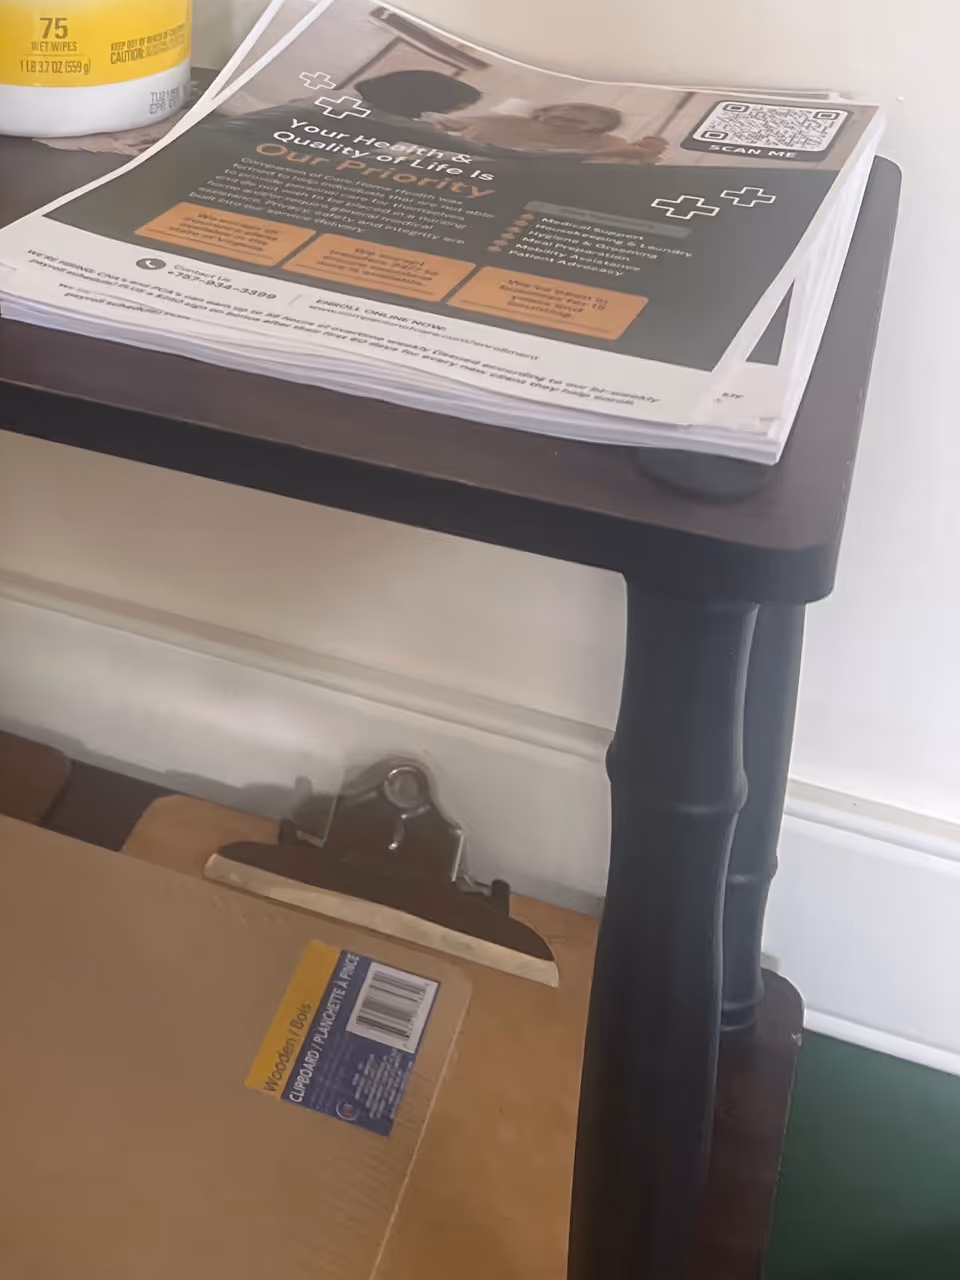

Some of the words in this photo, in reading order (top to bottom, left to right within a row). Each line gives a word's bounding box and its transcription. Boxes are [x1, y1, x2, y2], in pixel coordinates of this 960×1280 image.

[39, 17, 68, 39] 75
[31, 41, 49, 52] WET
[51, 41, 78, 52] WIPES
[290, 119, 350, 140] Your
[353, 134, 444, 160] Health
[451, 153, 473, 165] &
[708, 145, 761, 155] SCAN
[273, 131, 370, 159] Quality
[376, 153, 405, 164] of
[410, 158, 464, 175] Life
[469, 170, 496, 181] Is
[256, 143, 330, 166] Our
[335, 160, 496, 198] Priority
[533, 224, 624, 244] Housekeeping
[541, 218, 591, 229] Medical
[592, 228, 644, 240] Support
[508, 250, 554, 262] Patient
[315, 299, 359, 311] ENROLL
[365, 309, 408, 323] ONLINE
[411, 320, 447, 332] NOW:
[264, 1037, 296, 1092] Wooden
[289, 1002, 312, 1029] Bois
[289, 1050, 320, 1102] CLIPBOARD
[313, 988, 347, 1045] PLANCHETTE
